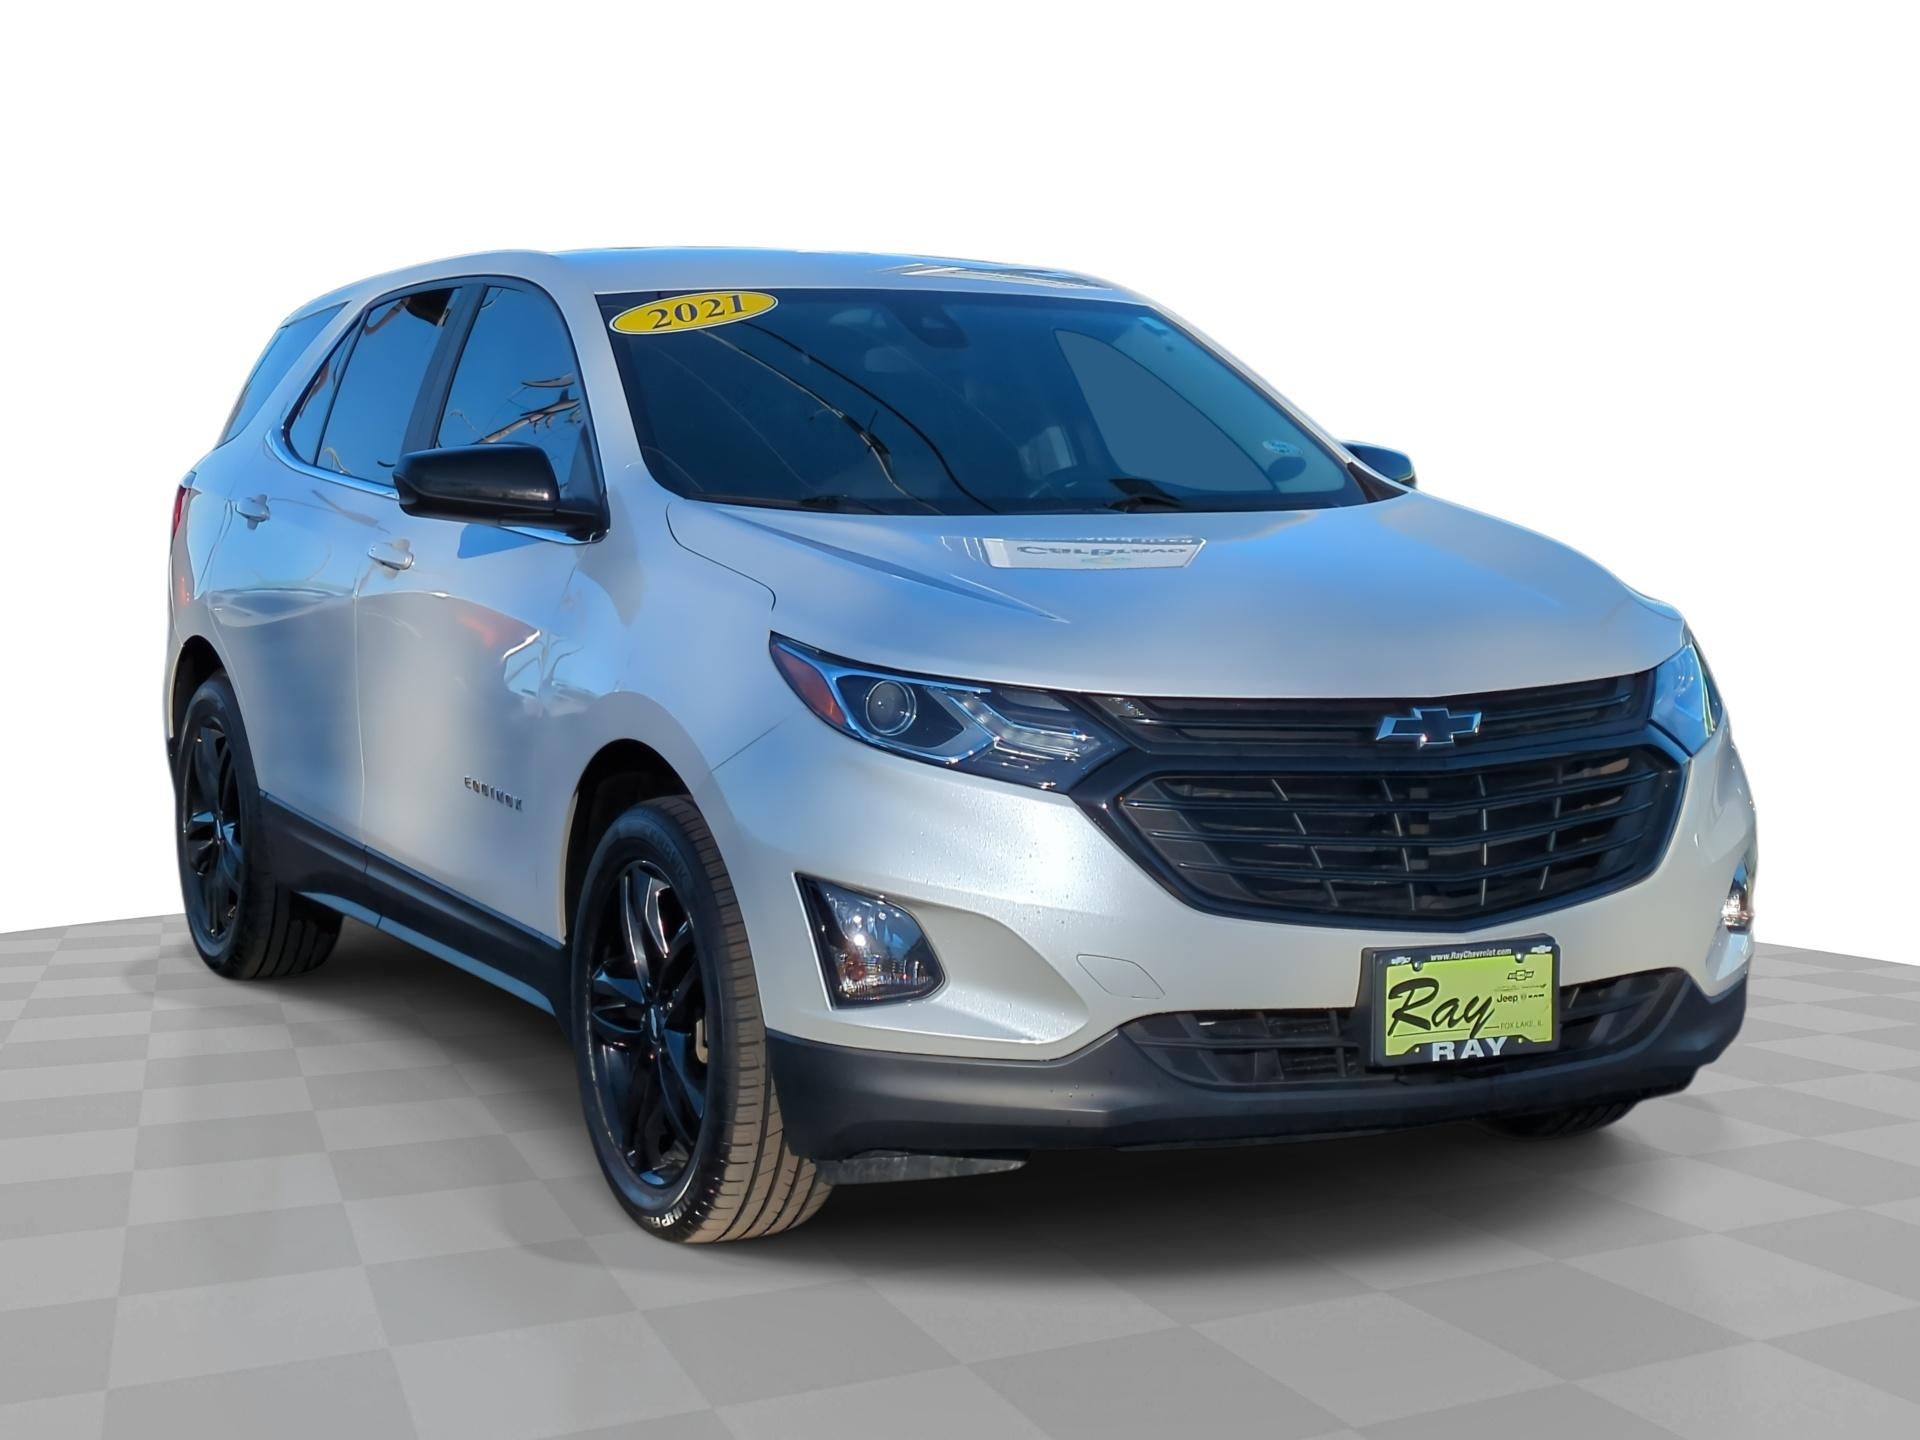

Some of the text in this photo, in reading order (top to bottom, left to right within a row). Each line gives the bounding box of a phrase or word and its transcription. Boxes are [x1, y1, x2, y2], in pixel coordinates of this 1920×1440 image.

[647, 294, 747, 329] 2021
[464, 776, 522, 812] EQUINOX
[1430, 948, 1512, 961] www.RayChevrolet.com
[1387, 977, 1495, 1040] Ray
[1497, 993, 1518, 1004] Jeep
[1500, 1021, 1514, 1031] FOX
[1432, 1036, 1508, 1062] RAY
